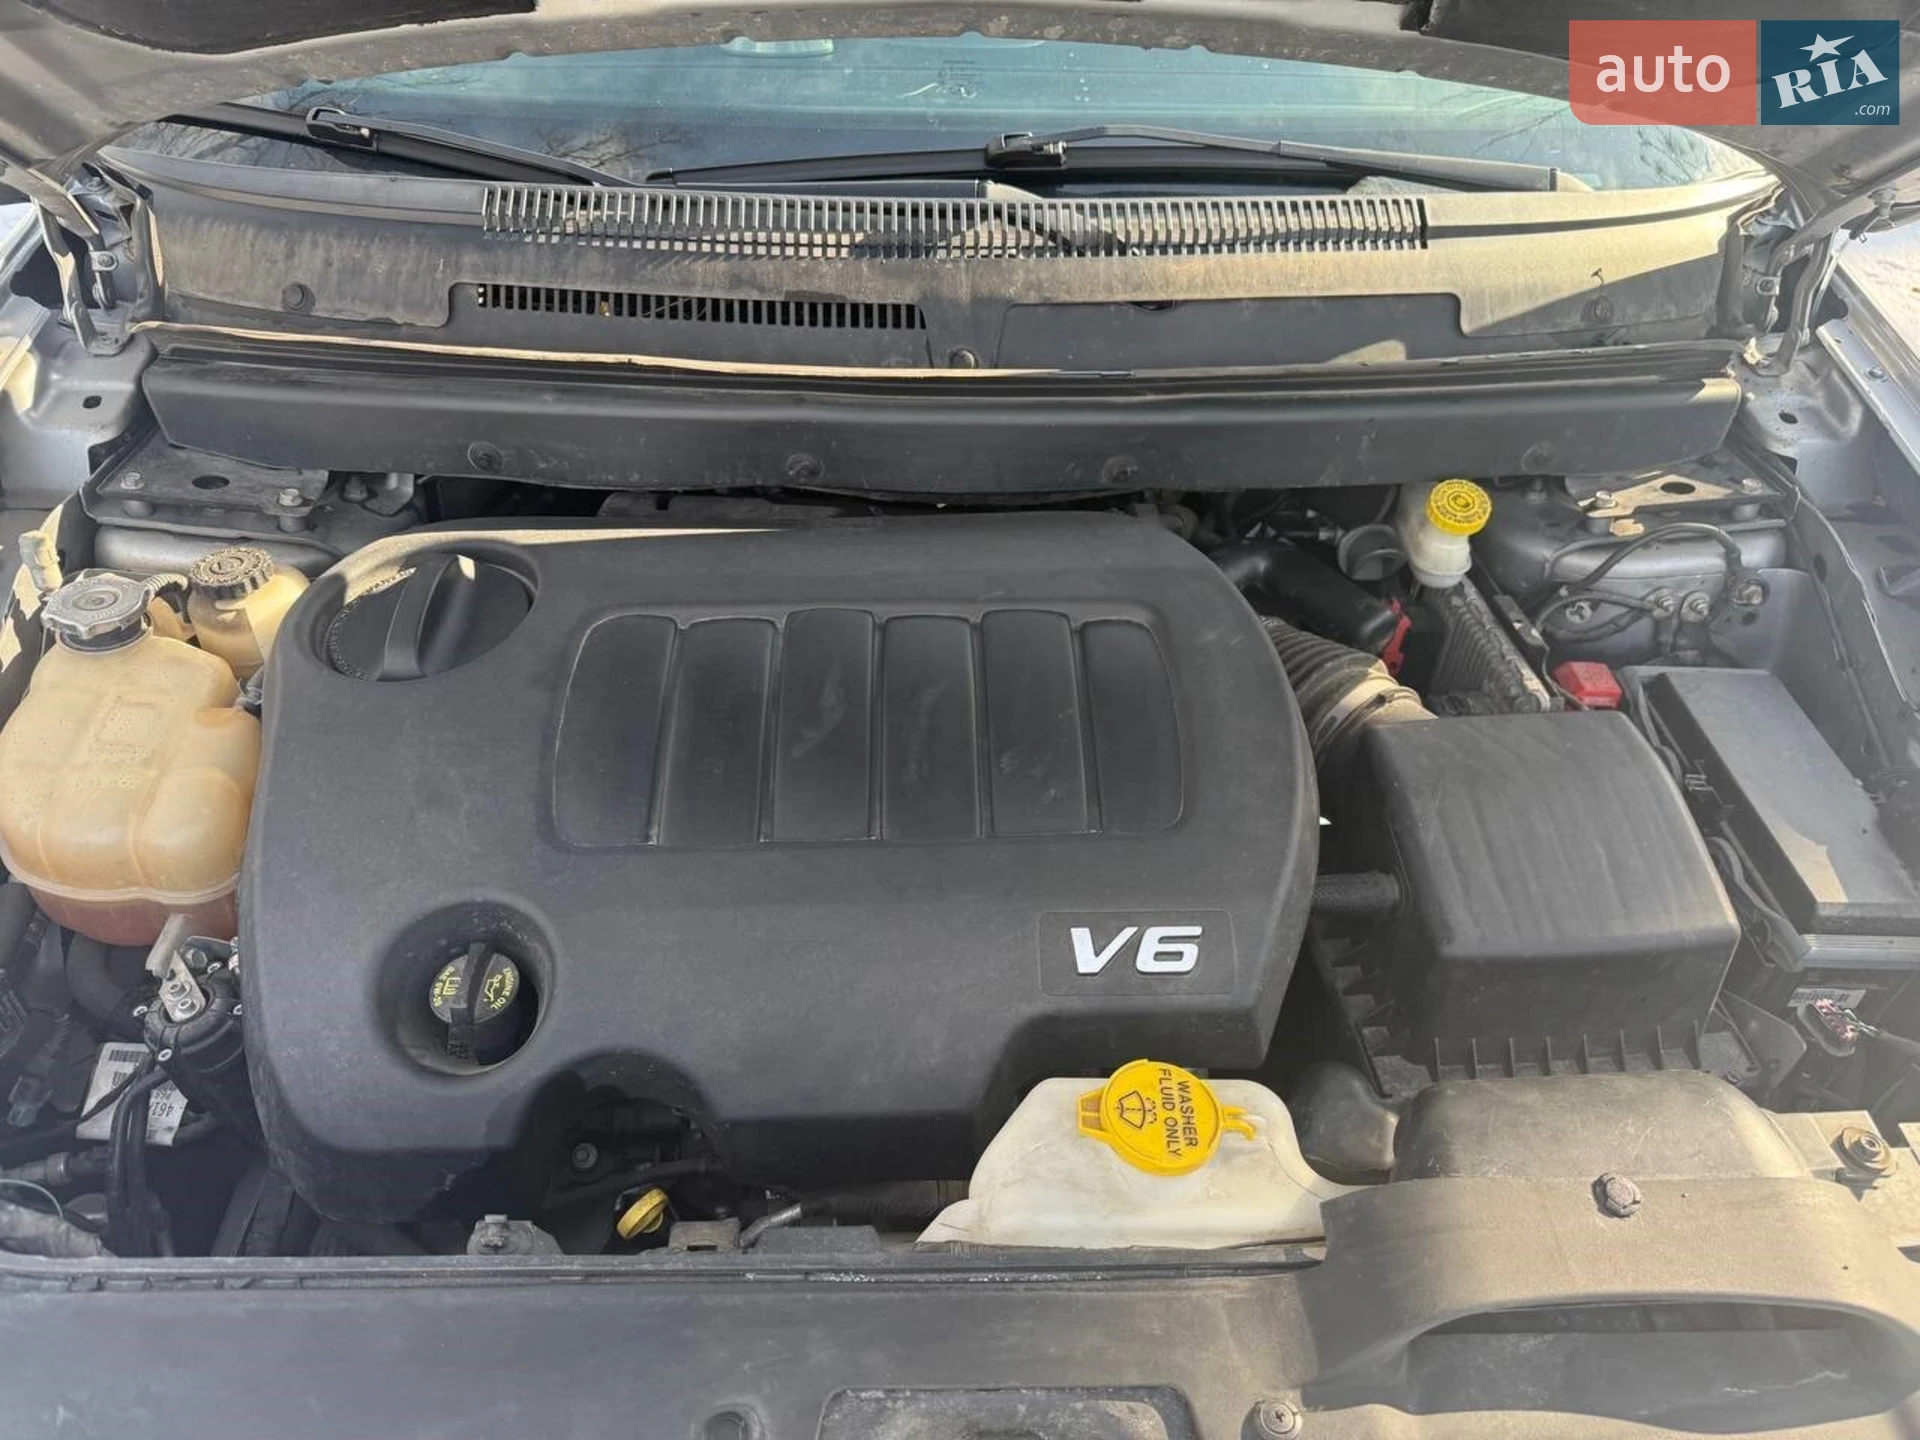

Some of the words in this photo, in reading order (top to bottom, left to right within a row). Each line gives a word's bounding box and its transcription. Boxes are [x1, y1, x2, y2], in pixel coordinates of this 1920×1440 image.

[1070, 926, 1203, 974] V6
[502, 967, 514, 997] ENGINE
[490, 997, 507, 1010] OIL
[149, 1101, 175, 1117] 461
[1158, 1067, 1177, 1112] FLUID
[1177, 1080, 1199, 1148] WASHER
[1163, 1116, 1184, 1157] ONLY
